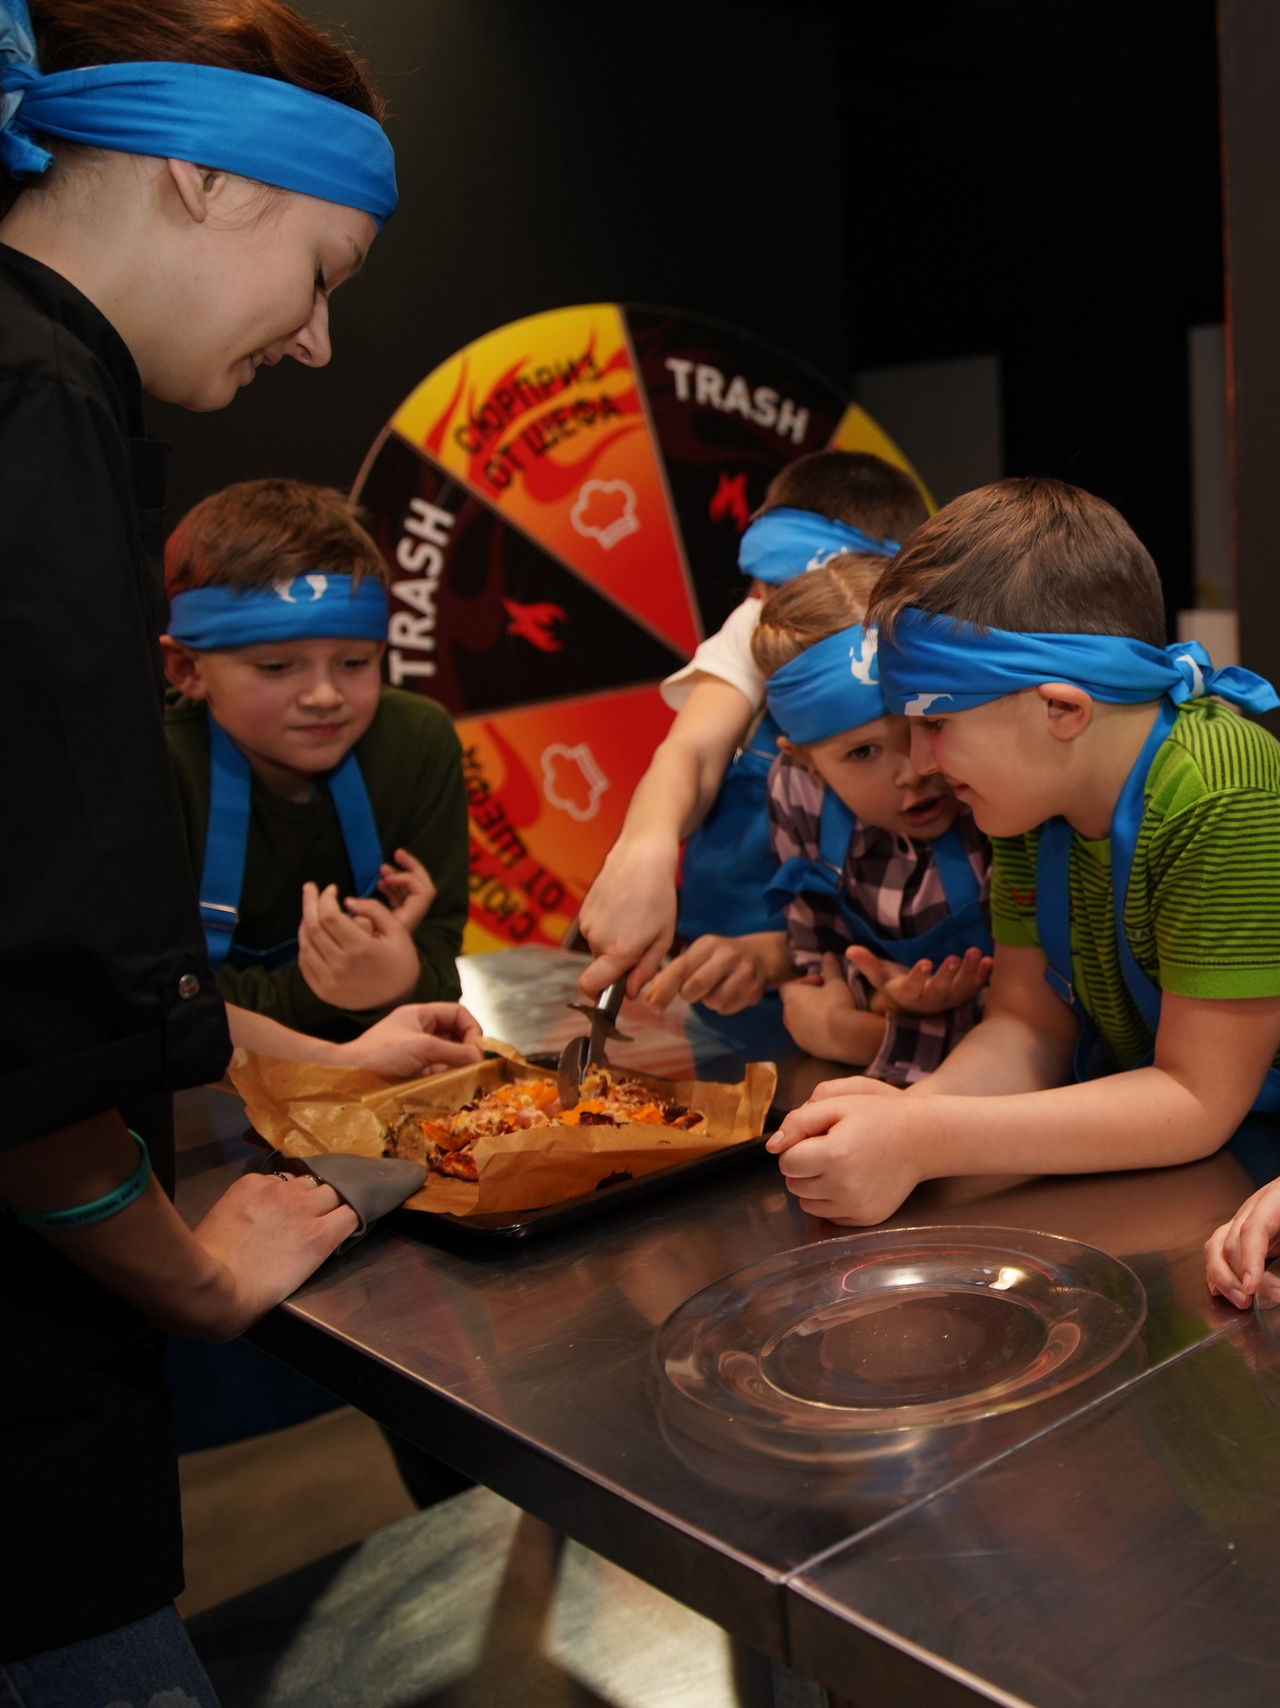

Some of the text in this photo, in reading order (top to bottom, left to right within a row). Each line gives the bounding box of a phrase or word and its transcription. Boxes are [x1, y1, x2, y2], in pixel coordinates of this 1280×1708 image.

[453, 354, 601, 454] СЮРПРИЗ
[484, 394, 621, 490] ОТ ШЕФА
[664, 357, 809, 445] TRASH
[388, 497, 456, 687] TRASH
[521, 867, 565, 911] ОТ
